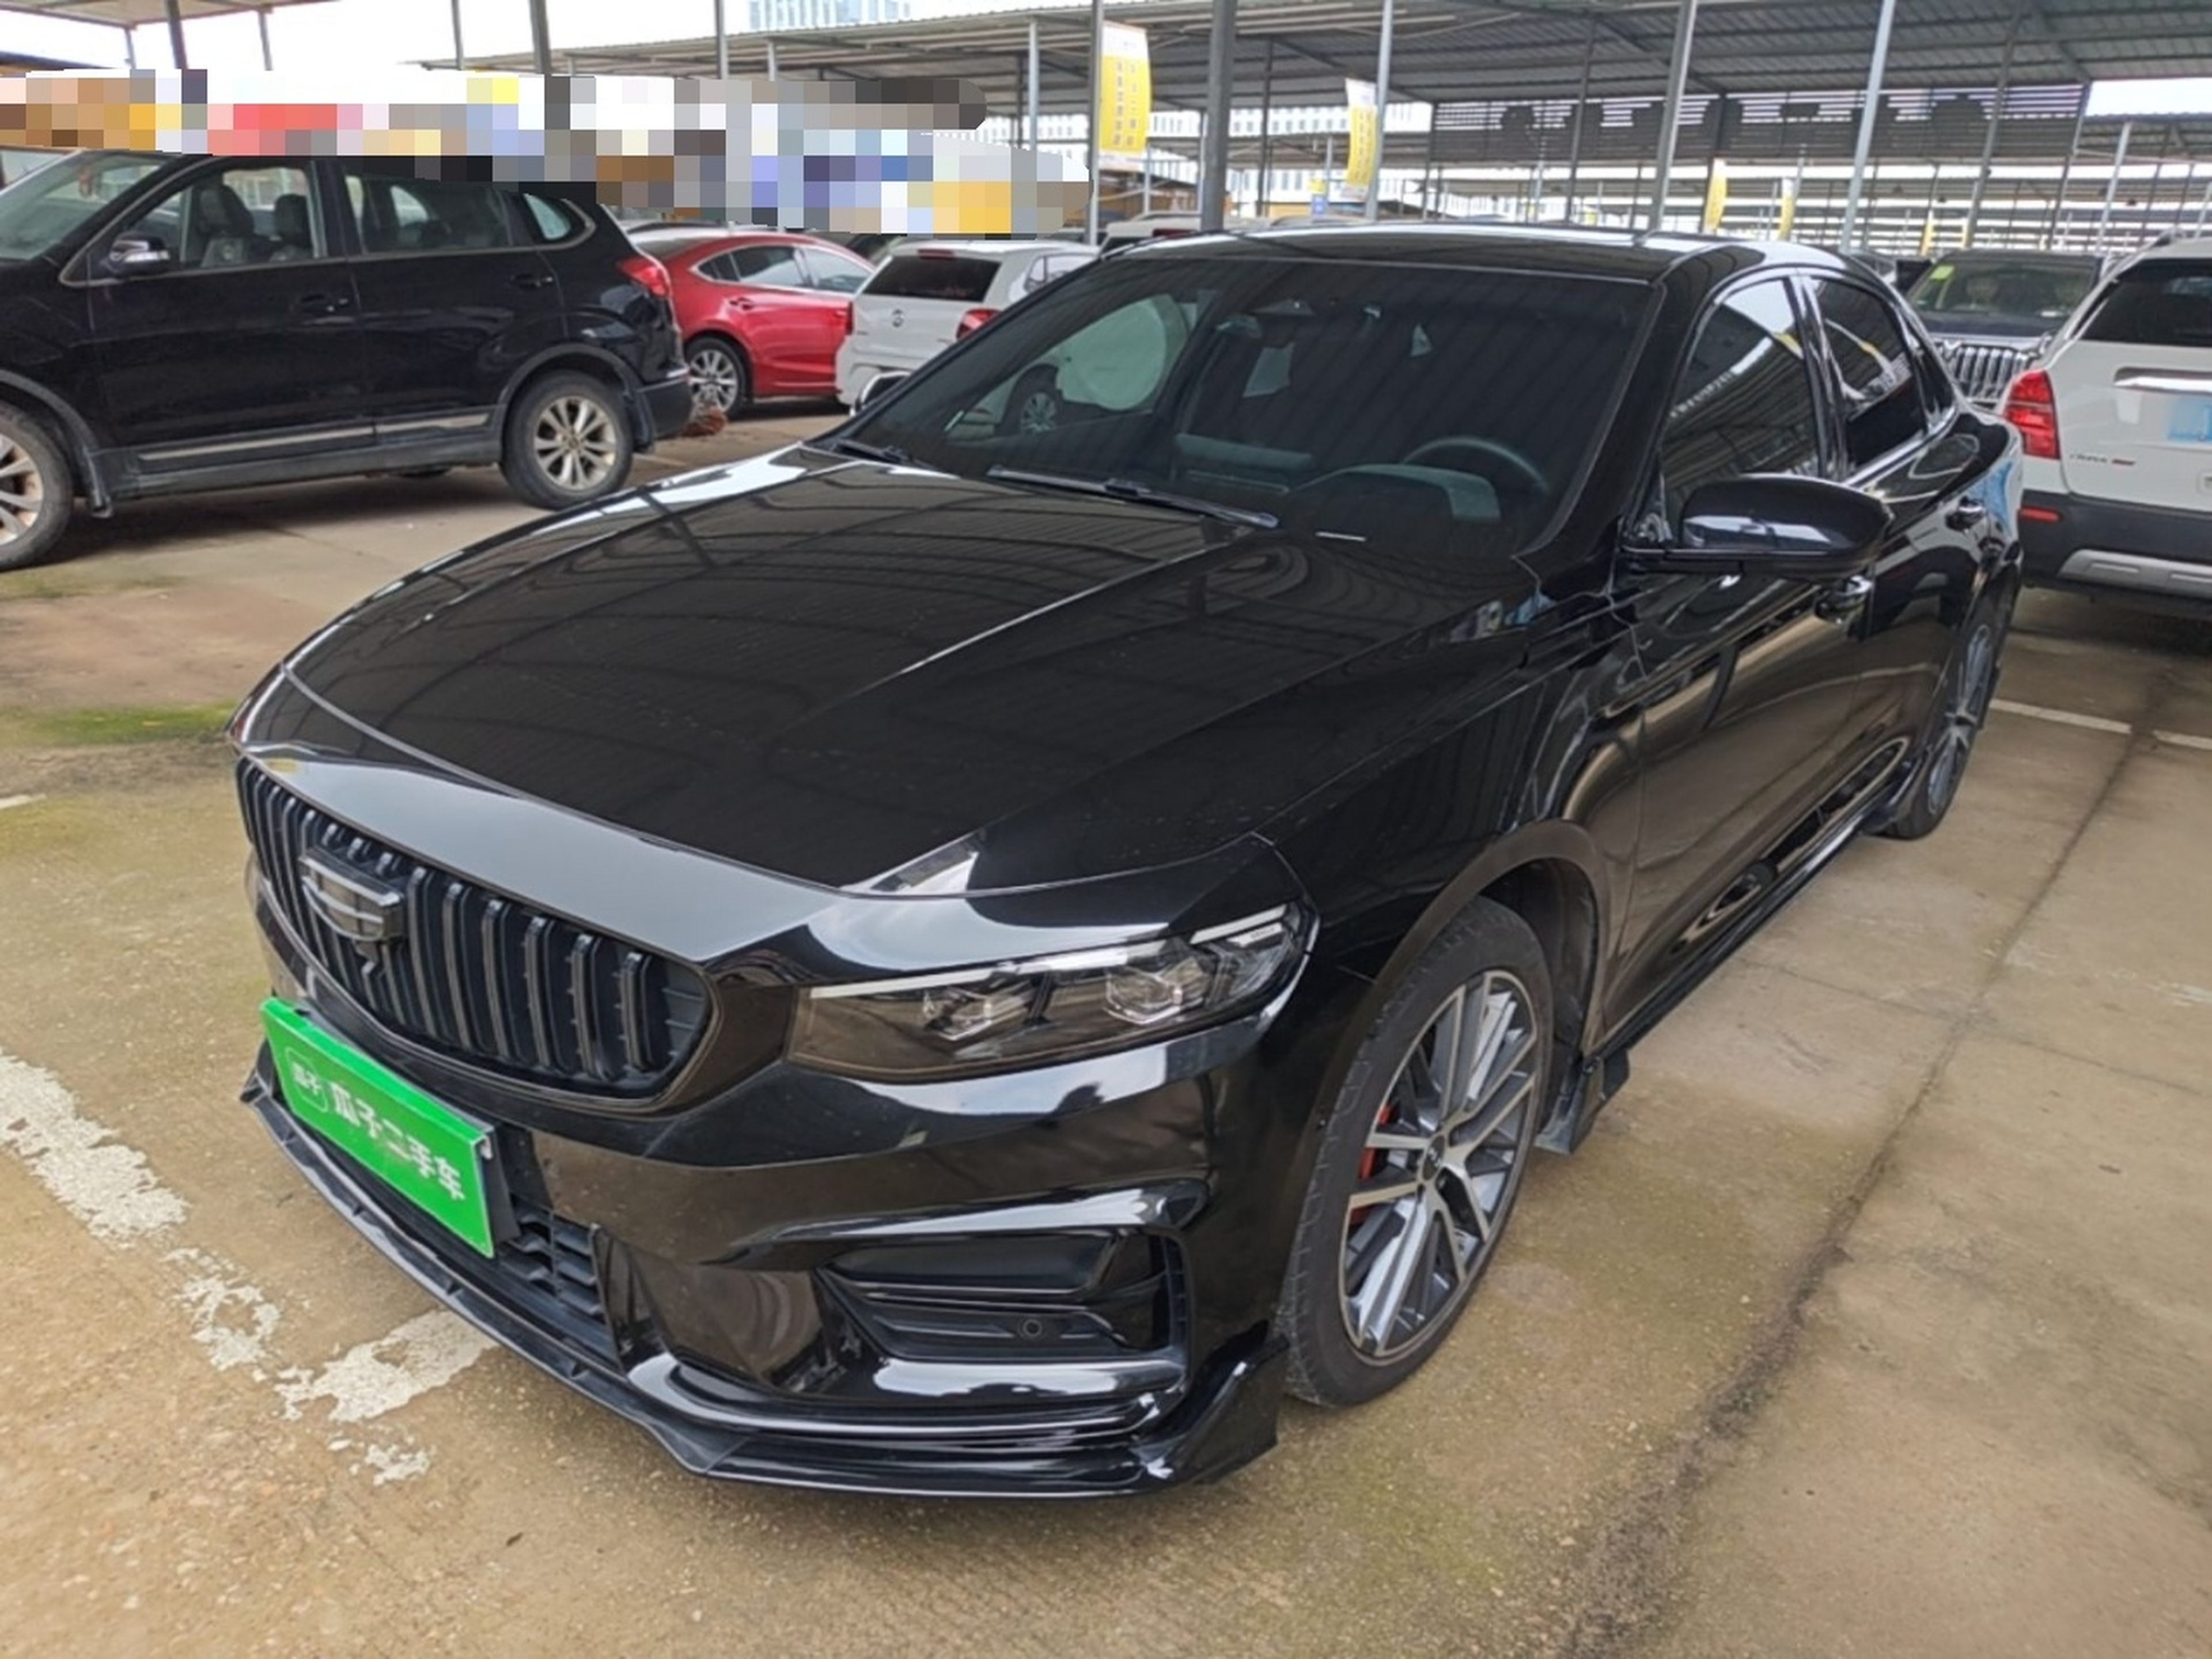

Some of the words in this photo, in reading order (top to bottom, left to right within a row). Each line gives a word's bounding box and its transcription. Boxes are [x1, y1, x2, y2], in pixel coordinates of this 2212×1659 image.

[329, 1081, 465, 1200] 瓜子二手车
